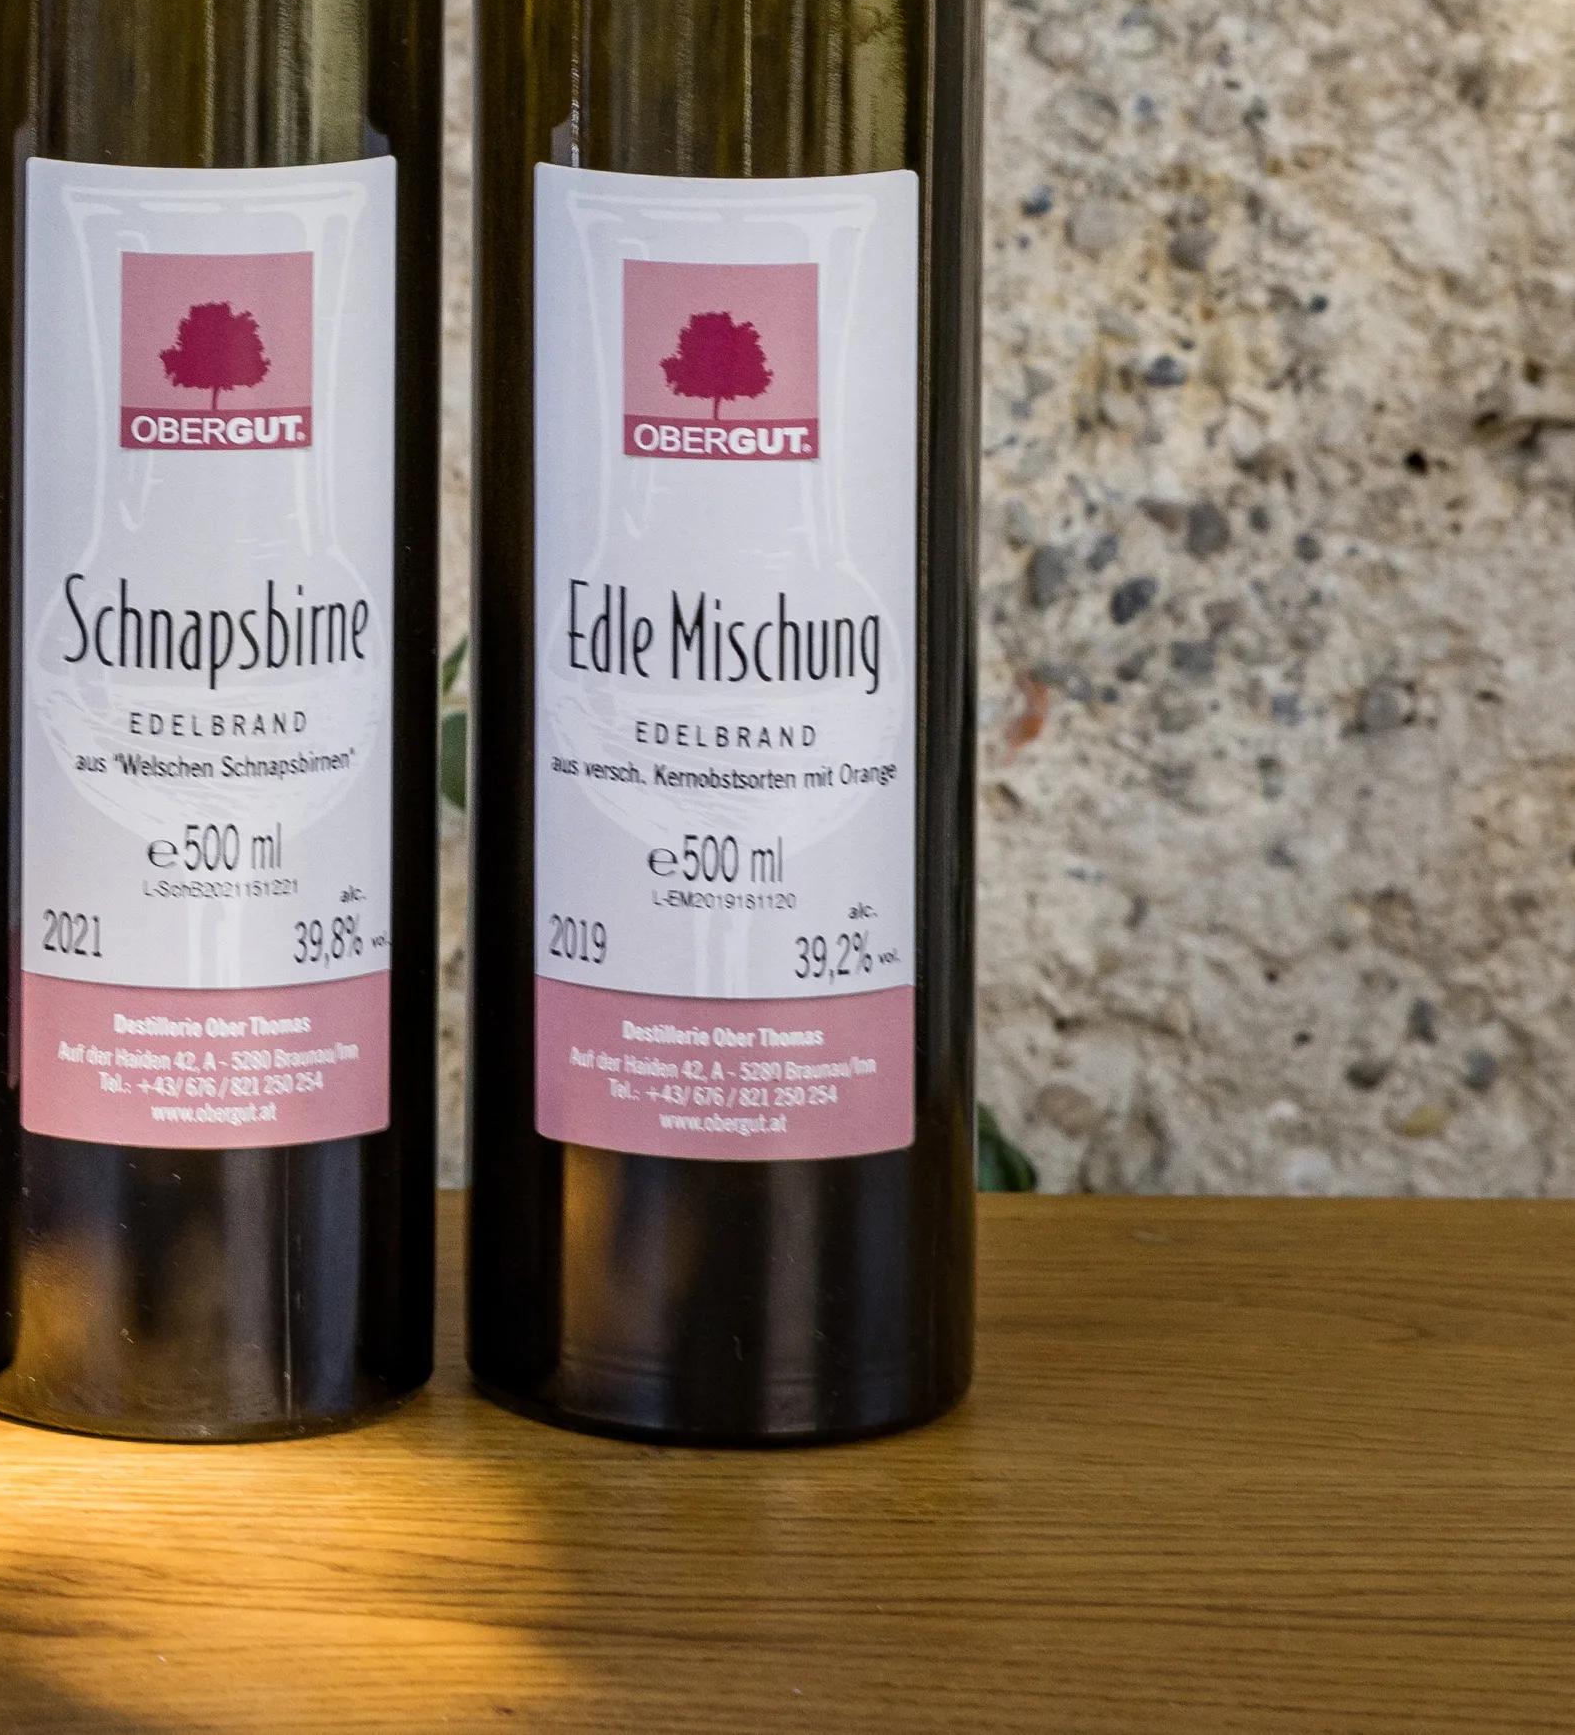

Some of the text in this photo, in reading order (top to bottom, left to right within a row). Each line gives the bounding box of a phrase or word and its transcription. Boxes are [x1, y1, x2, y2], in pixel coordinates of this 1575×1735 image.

[63, 573, 368, 690] Schnapsbirne
[568, 578, 879, 695] Edle Mischung
[129, 711, 307, 737] EDELBRAND
[635, 721, 816, 747] EDELBRAND
[75, 755, 107, 773] aus
[551, 756, 897, 789] aus versch. Kernobstsorten mit Orange
[252, 822, 282, 870] ml
[751, 836, 783, 883] ml
[43, 908, 103, 958] 2021
[294, 914, 363, 969] 39,8%
[549, 914, 607, 964] 2019
[795, 931, 873, 985] 39,2%
[249, 1016, 312, 1036] Thomas
[758, 1027, 824, 1046] Thomas
